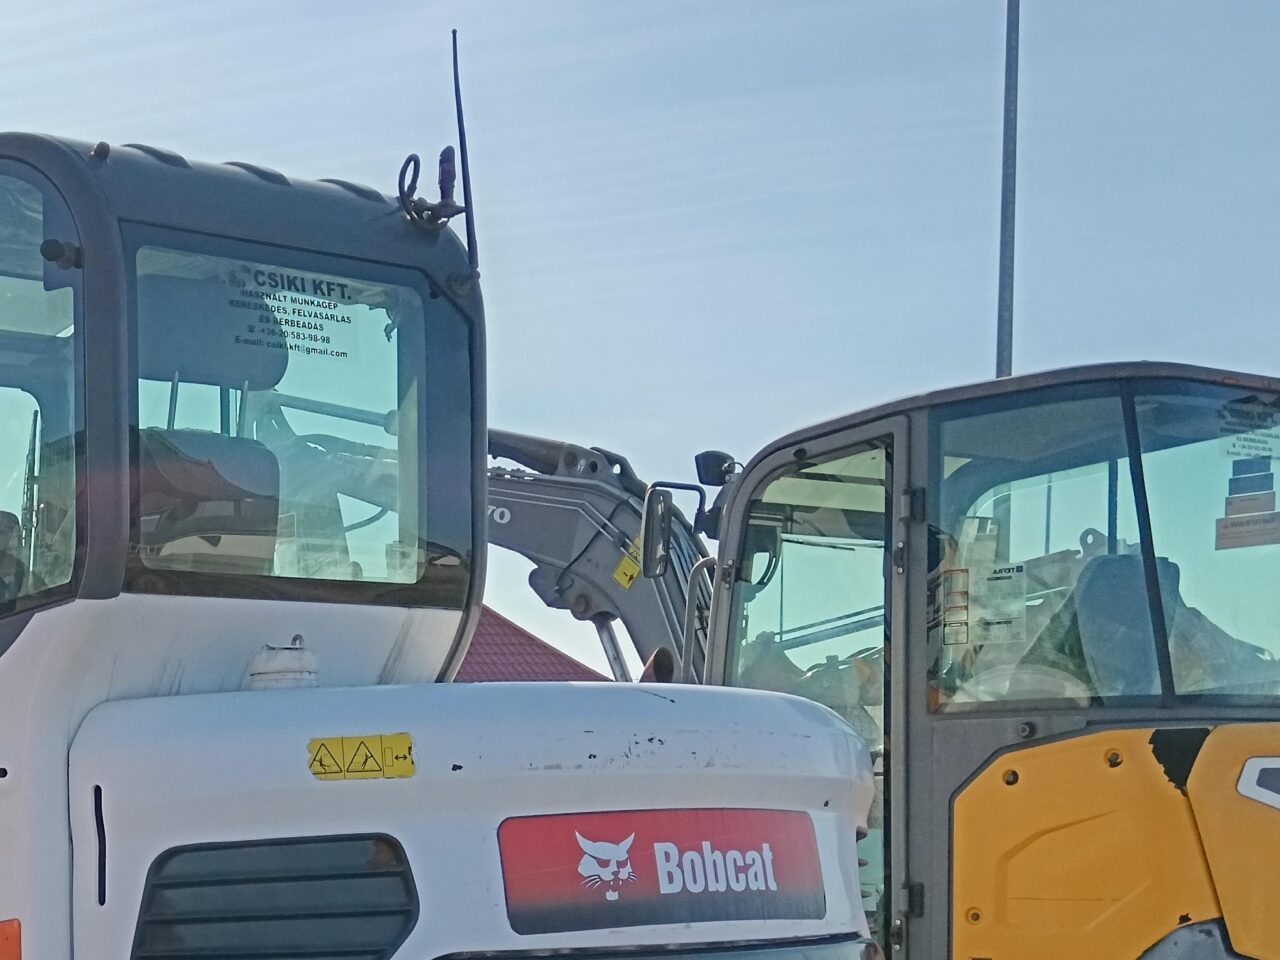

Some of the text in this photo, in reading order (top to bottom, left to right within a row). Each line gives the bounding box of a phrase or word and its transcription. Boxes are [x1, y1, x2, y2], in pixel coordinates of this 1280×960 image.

[253, 269, 352, 300] CSIKI KFT.
[653, 841, 778, 895] Bobcat
